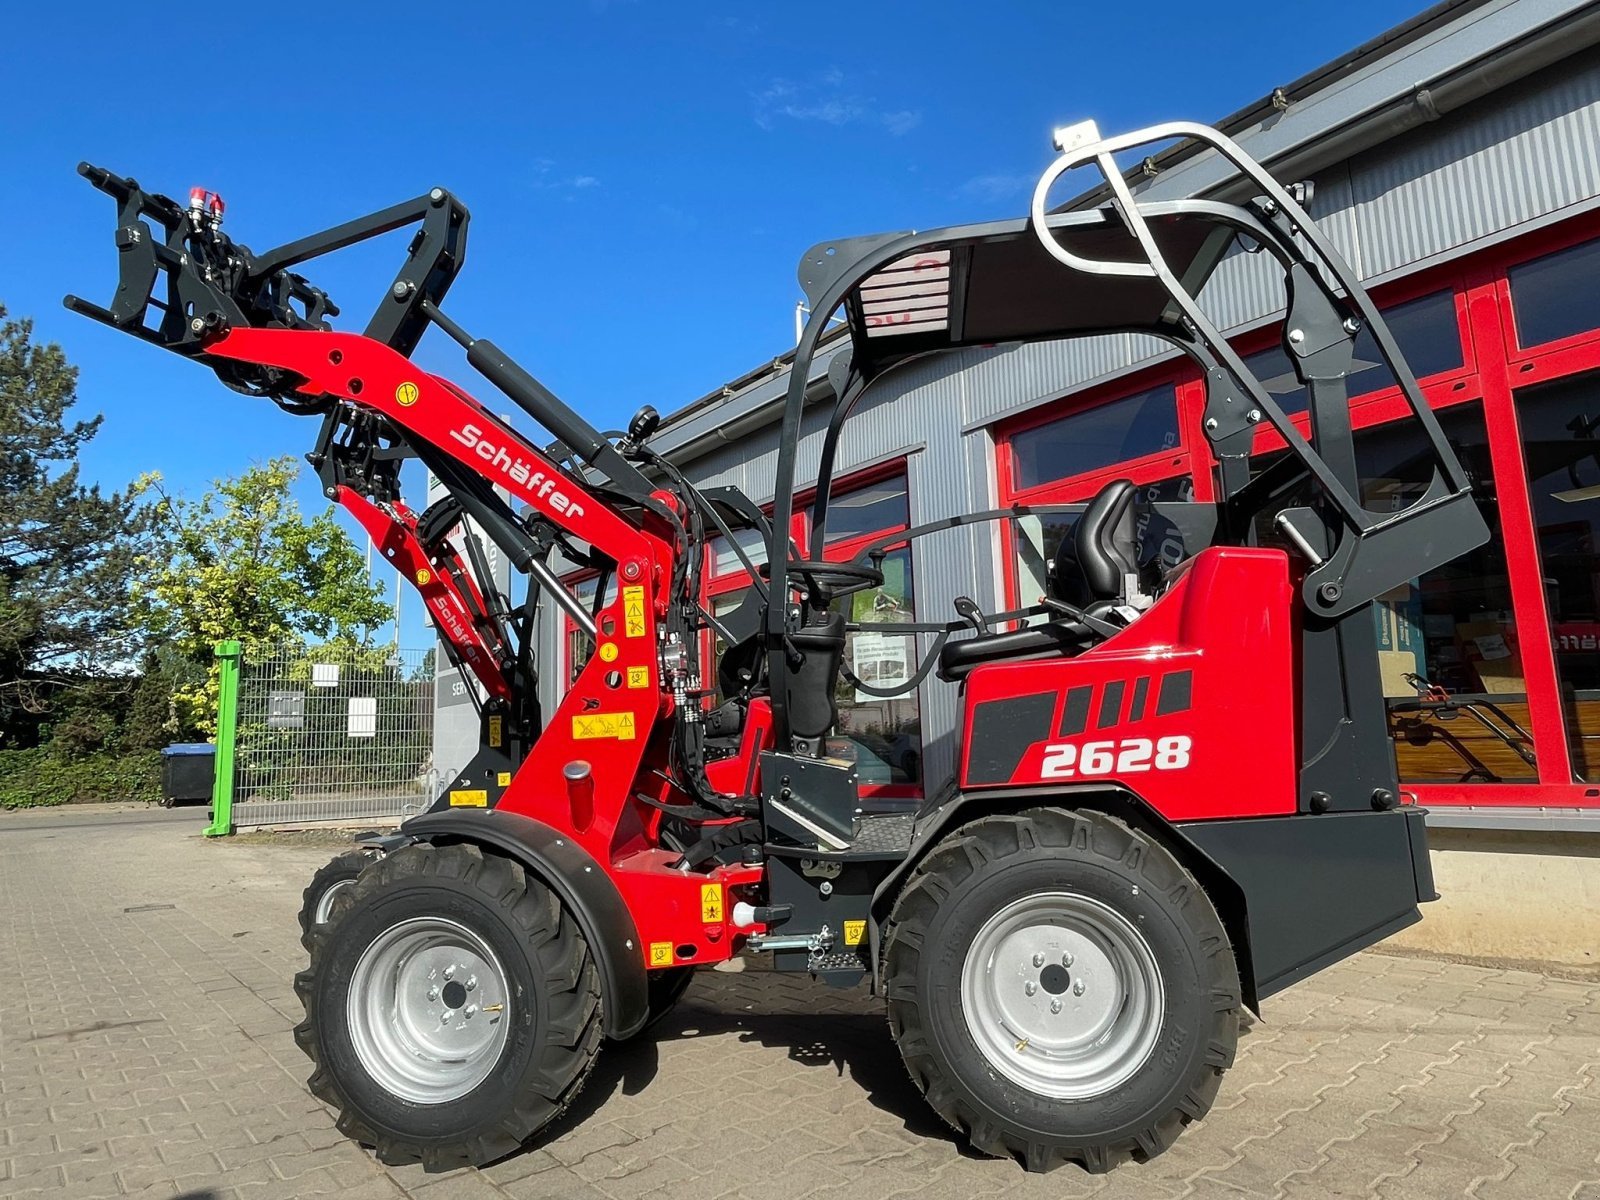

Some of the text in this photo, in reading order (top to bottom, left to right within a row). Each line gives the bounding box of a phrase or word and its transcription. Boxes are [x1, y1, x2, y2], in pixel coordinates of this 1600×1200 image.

[449, 424, 584, 518] Schäffer
[433, 597, 480, 663] Schäffer
[1040, 735, 1192, 778] 2628
